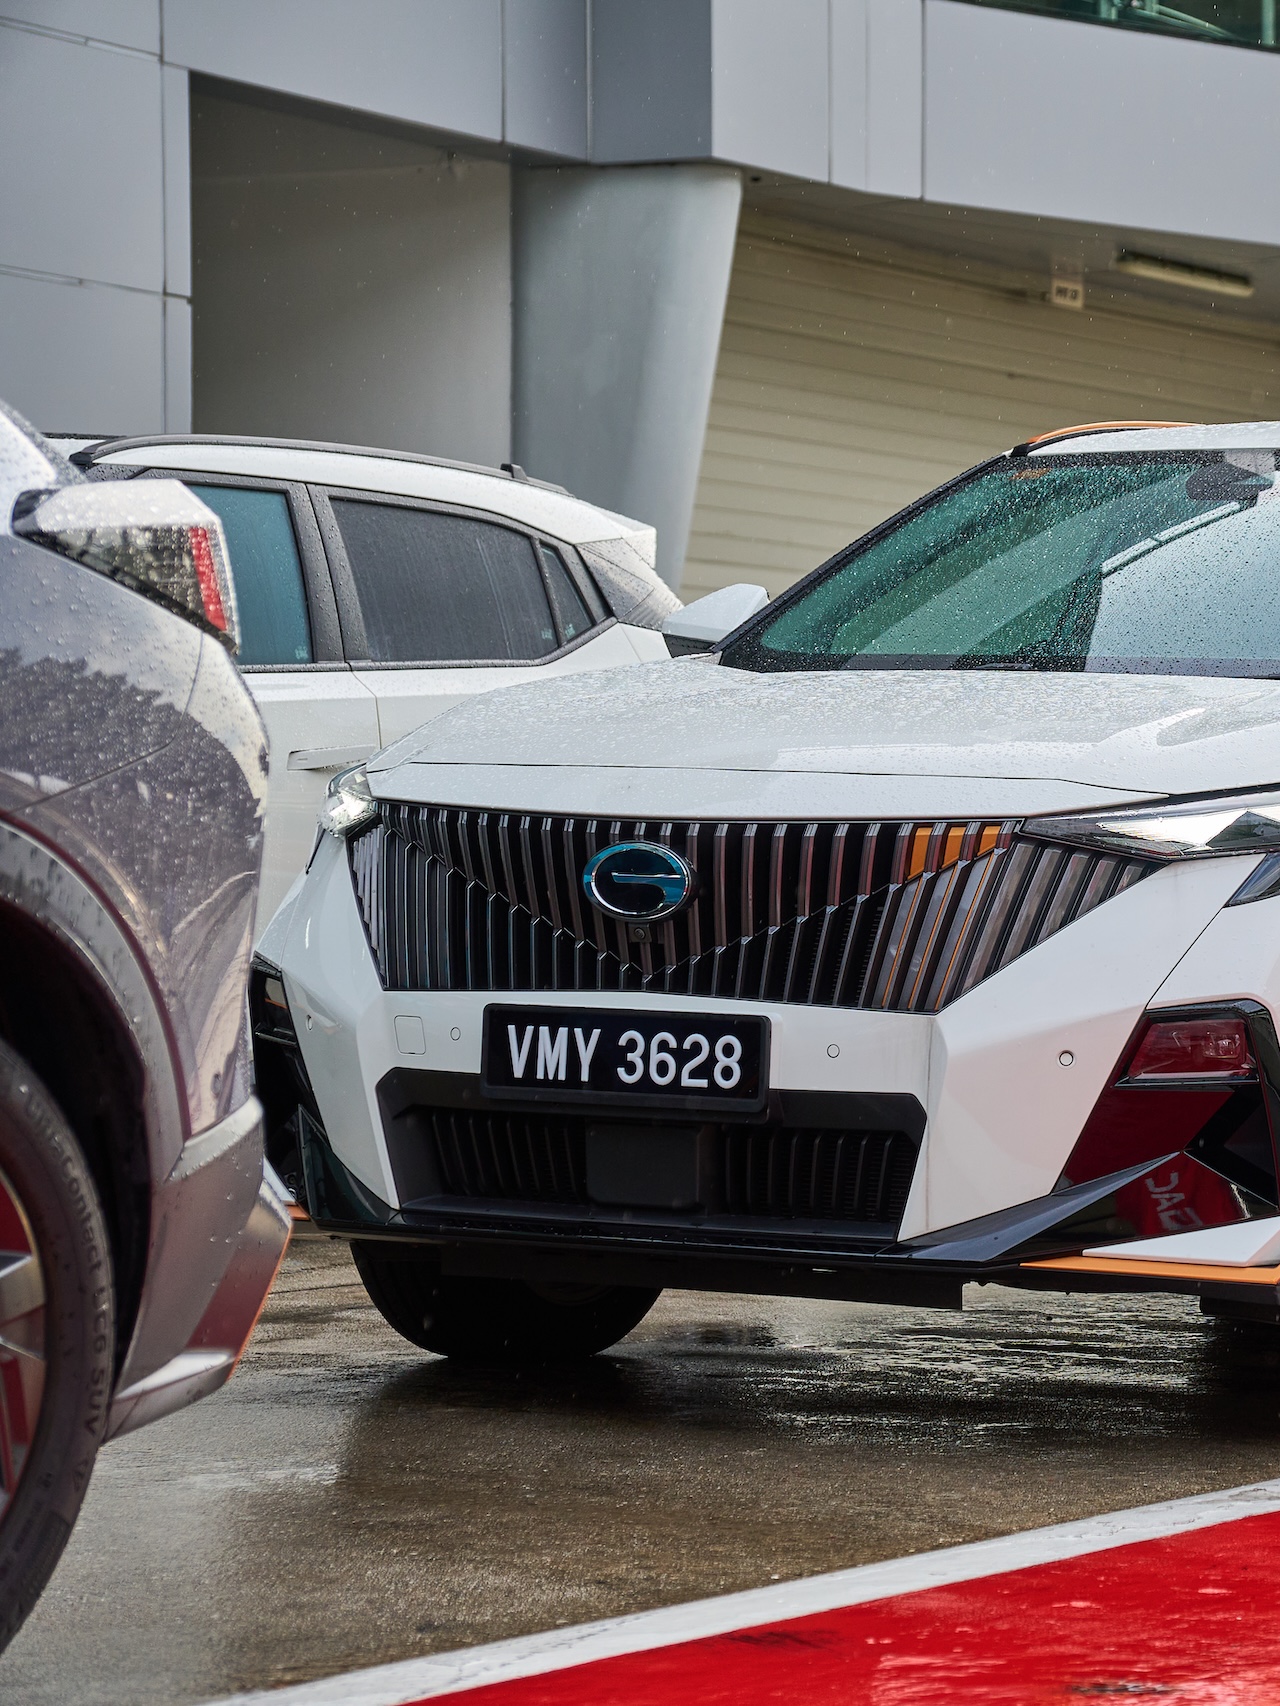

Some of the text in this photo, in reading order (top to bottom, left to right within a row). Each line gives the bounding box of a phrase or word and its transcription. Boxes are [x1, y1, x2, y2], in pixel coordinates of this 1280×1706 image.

[507, 1024, 742, 1089] VMY 3628
[84, 1367, 105, 1437] SUV
